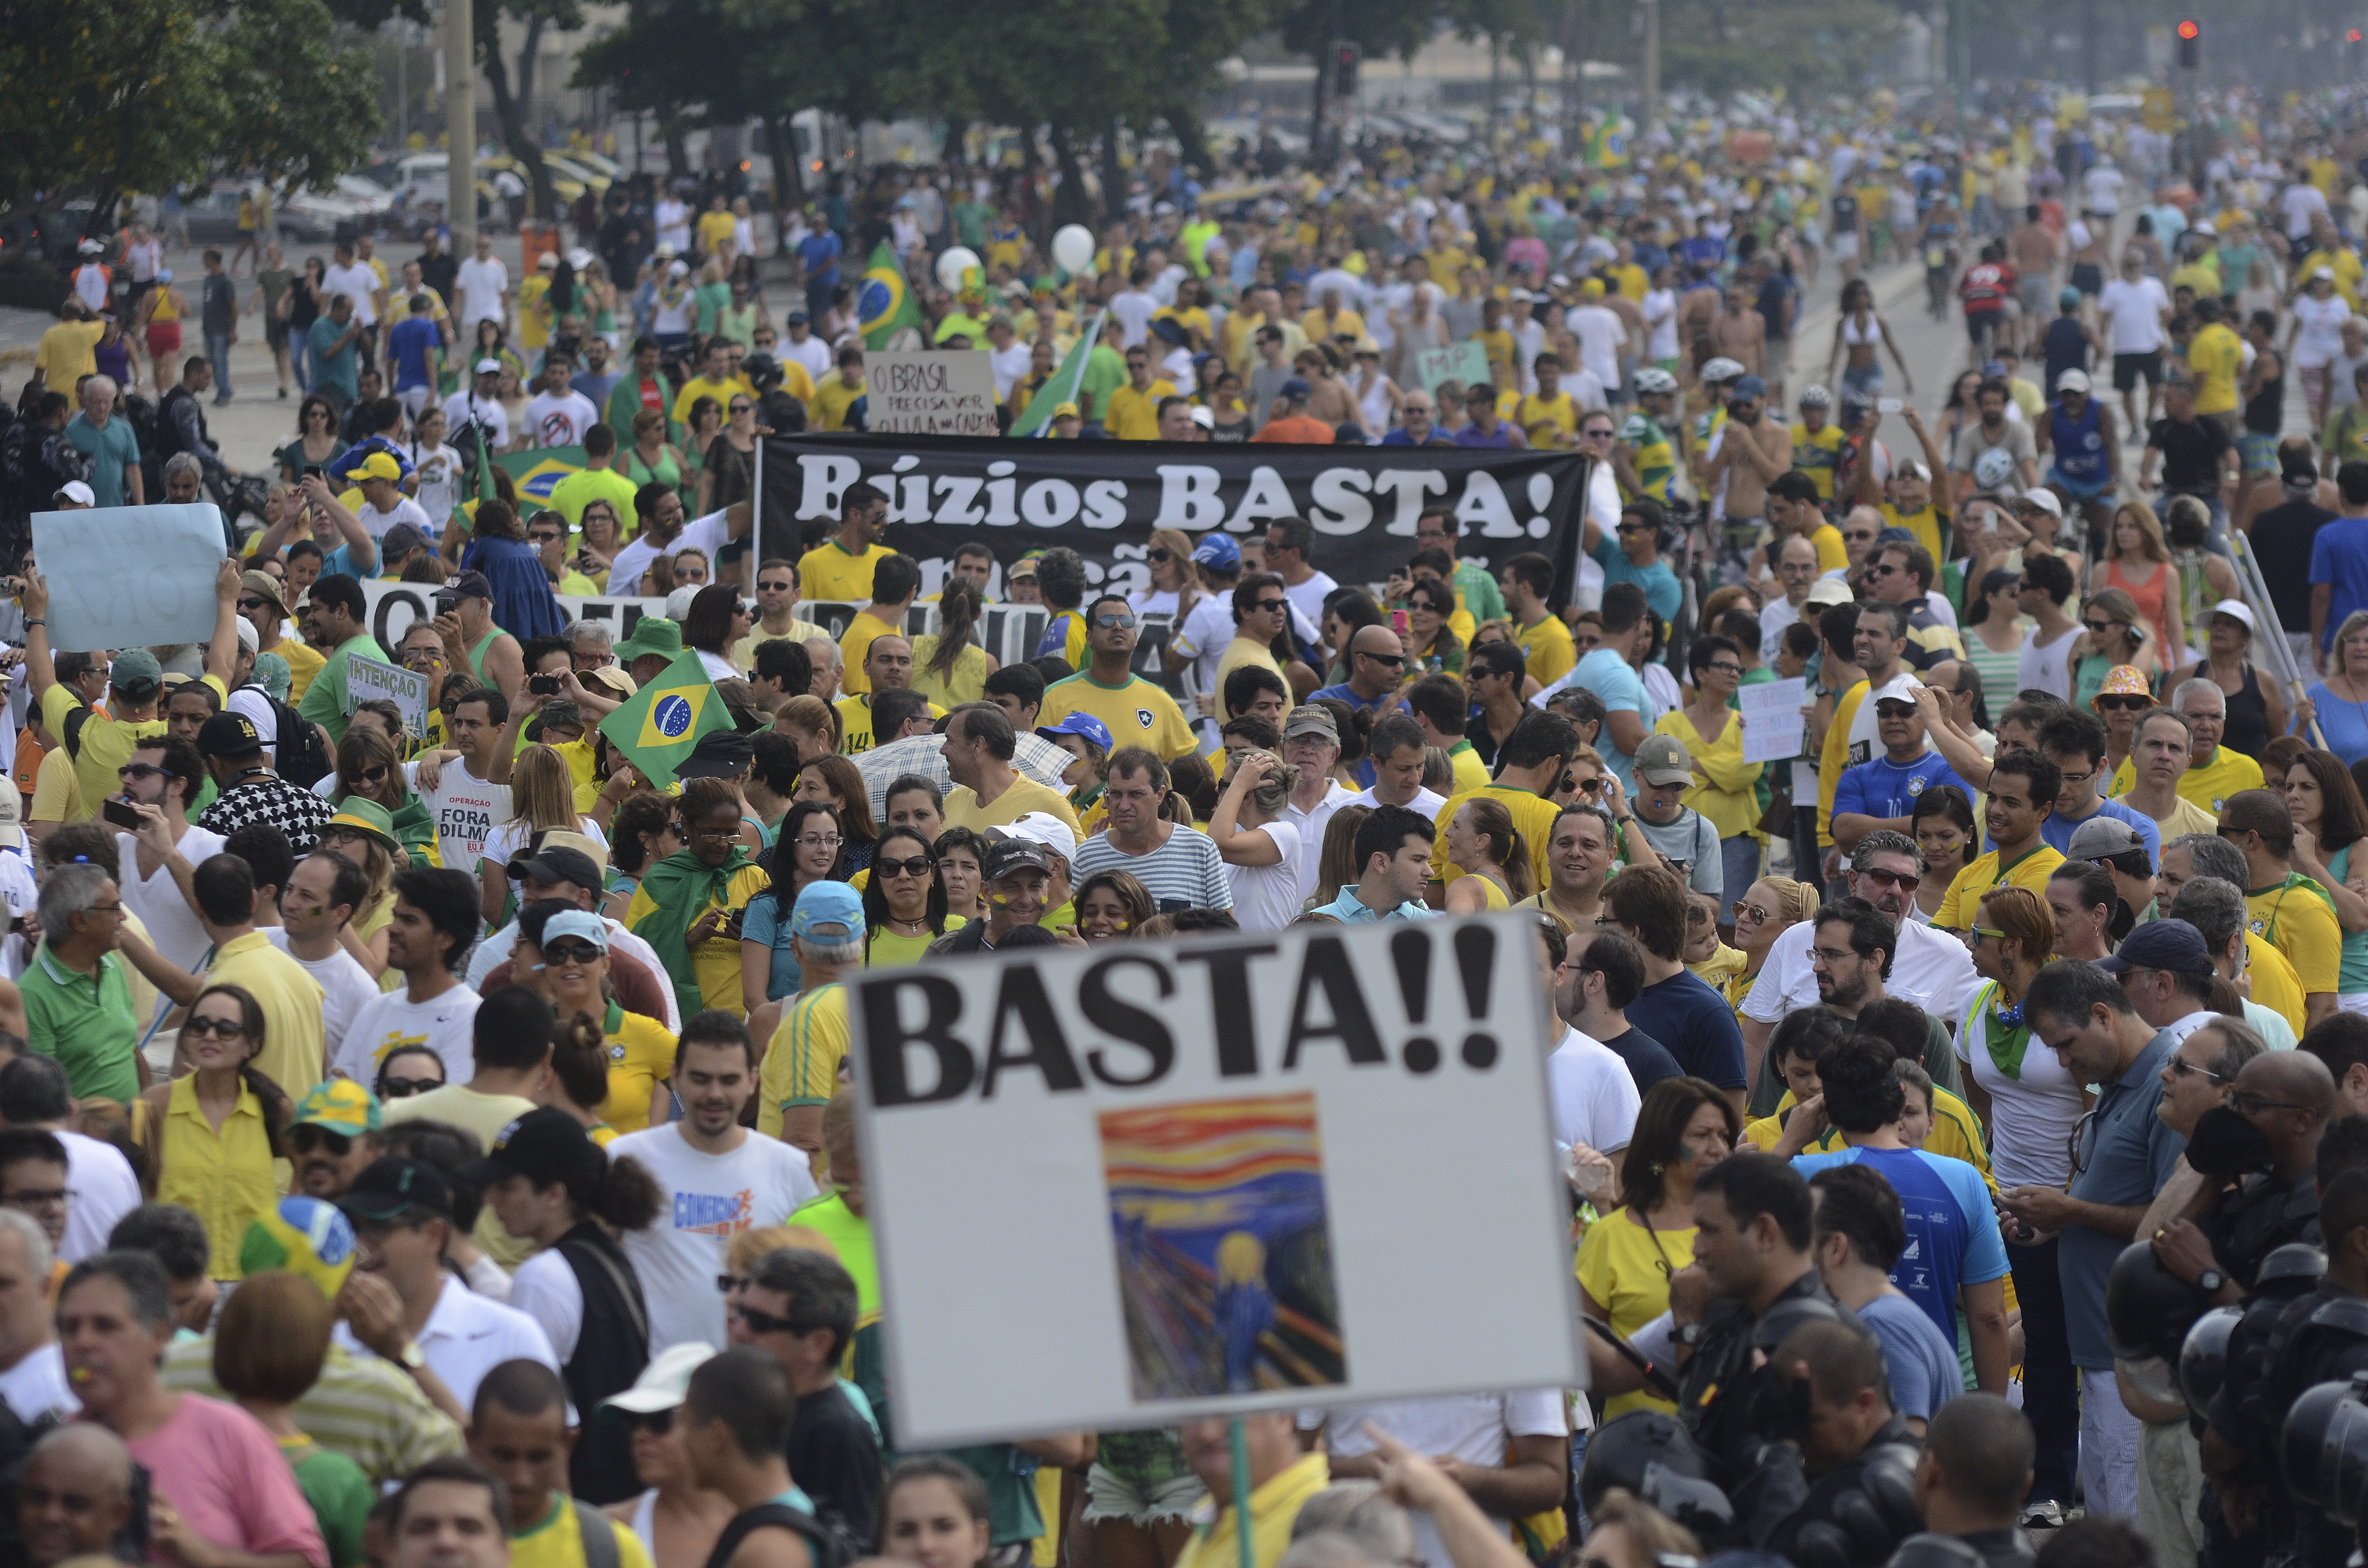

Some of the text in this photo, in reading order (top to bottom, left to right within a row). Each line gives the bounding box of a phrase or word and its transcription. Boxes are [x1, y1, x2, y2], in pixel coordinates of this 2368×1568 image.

[891, 363, 955, 393] BRASIL
[888, 394, 985, 412] PRECISA VER
[795, 453, 1554, 539] Búzios BASTA!
[237, 719, 256, 738] LA
[847, 732, 869, 755] 14
[449, 797, 491, 808] OPERAÇÃO
[441, 808, 491, 827] FORA
[467, 843, 477, 851] EU
[703, 947, 741, 955] APAIXONAD
[859, 924, 1499, 1107] BASTA!!
